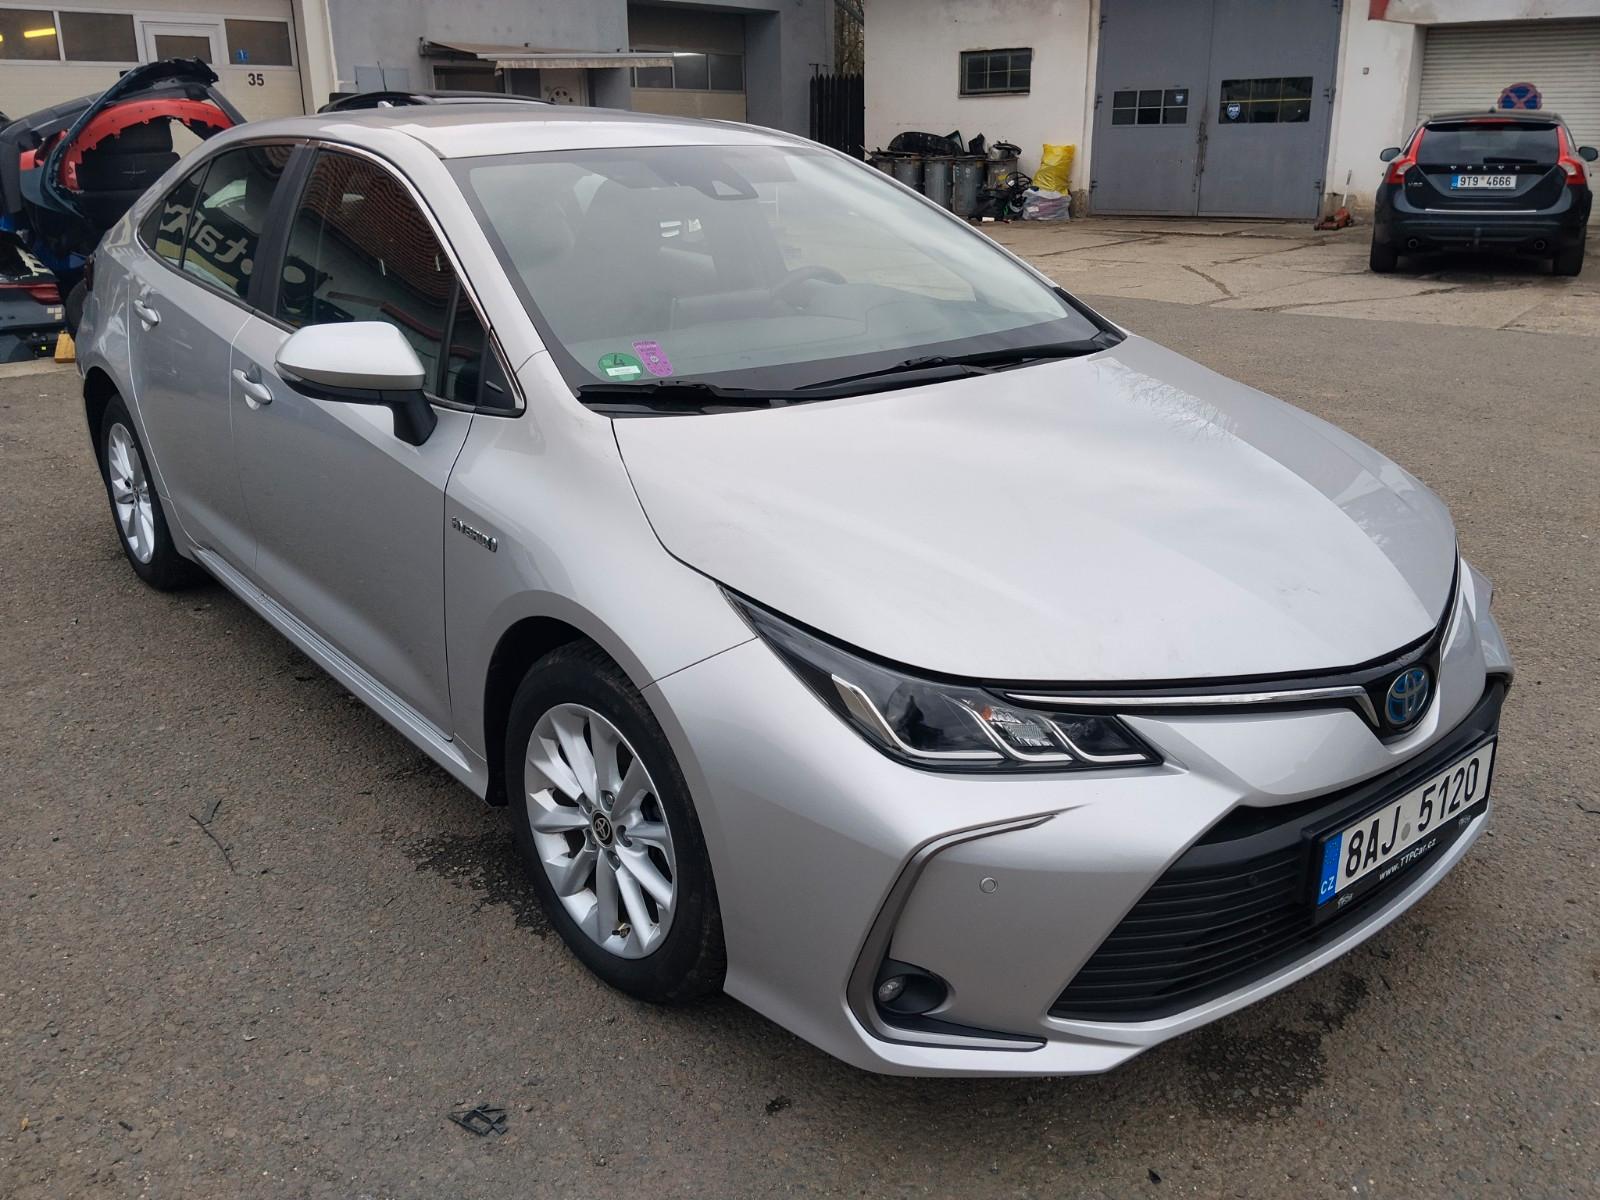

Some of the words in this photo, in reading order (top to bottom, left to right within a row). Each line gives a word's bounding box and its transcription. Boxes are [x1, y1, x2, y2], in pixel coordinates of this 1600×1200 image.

[248, 73, 265, 87] 35
[1460, 176, 1479, 186] 9T9
[1486, 176, 1511, 186] 4666
[1345, 805, 1401, 878] 8AJ
[1418, 757, 1480, 832] 5120
[1320, 875, 1335, 895] CZ
